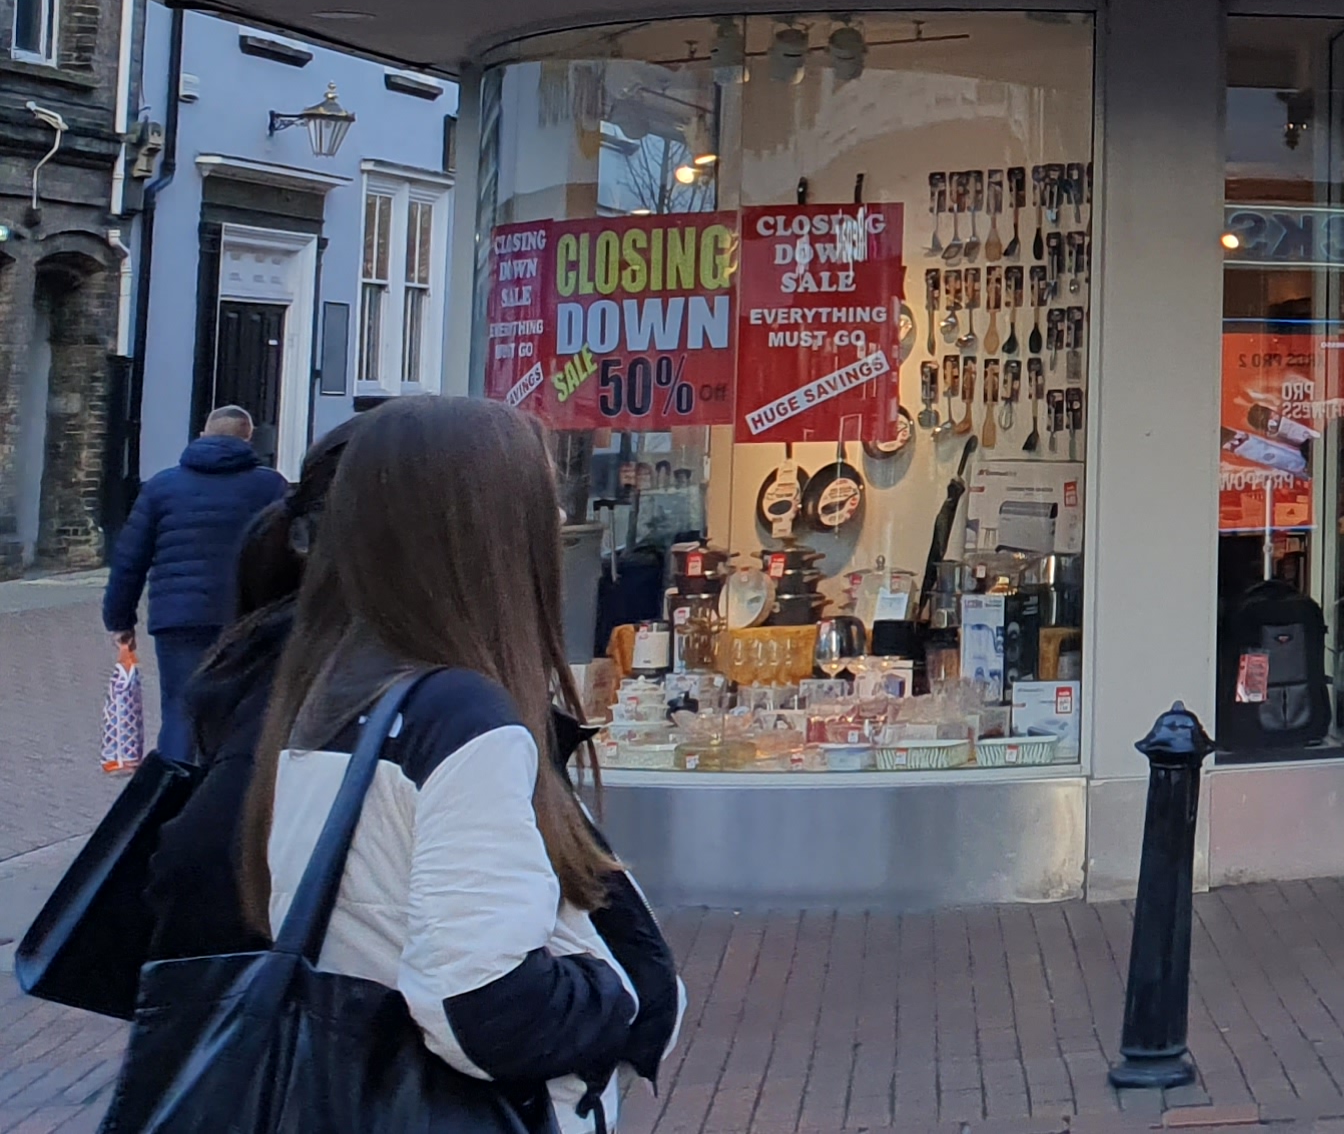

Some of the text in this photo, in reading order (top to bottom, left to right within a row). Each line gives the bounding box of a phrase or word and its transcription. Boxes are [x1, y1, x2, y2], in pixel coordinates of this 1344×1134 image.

[556, 224, 731, 298] CLOSING
[774, 242, 867, 265] DOW
[780, 271, 856, 293] SALE
[556, 295, 730, 355] DOWN
[750, 306, 888, 325] EVERYTHING
[768, 329, 867, 348] MUST GO
[509, 366, 542, 406] AVINGS
[553, 342, 599, 403] SALE
[599, 354, 694, 418] 50%
[751, 355, 885, 431] HUGE SAVINGS
